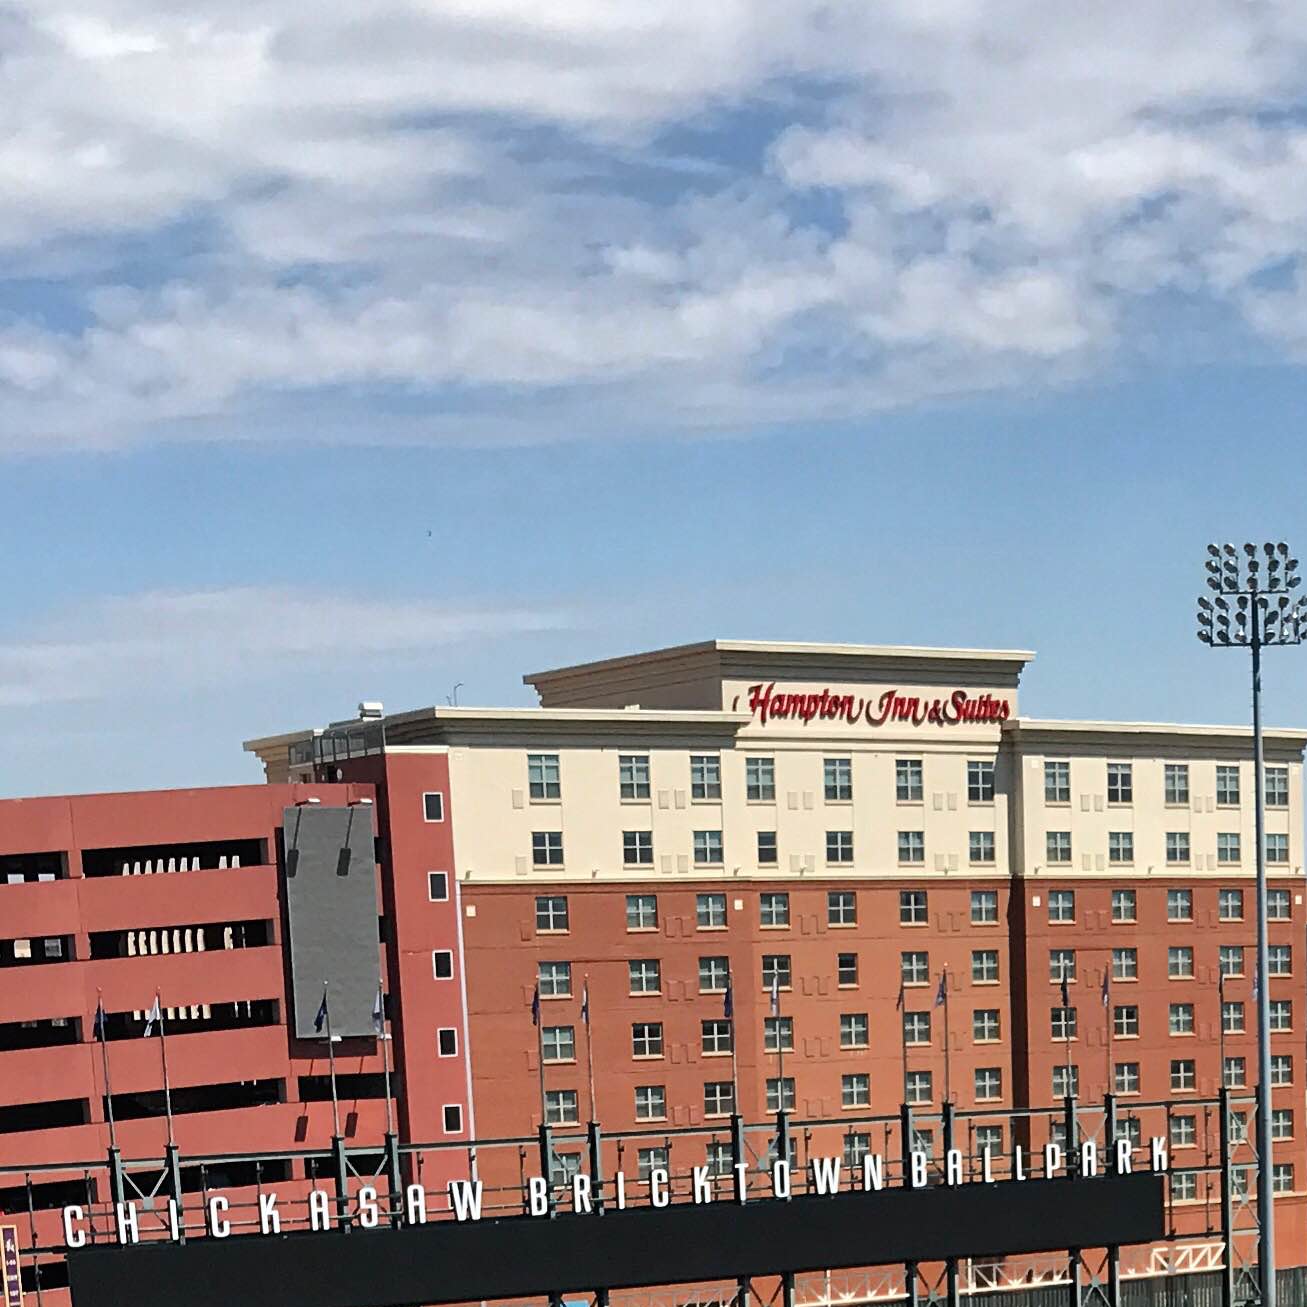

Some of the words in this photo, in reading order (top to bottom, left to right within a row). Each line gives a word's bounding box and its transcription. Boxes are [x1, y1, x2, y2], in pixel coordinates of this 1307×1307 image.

[748, 681, 864, 727] Hampton
[866, 690, 928, 727] Inn
[943, 690, 1010, 725] Suites
[63, 1181, 484, 1249] CHICKASAW
[530, 1154, 884, 1217] BRICKTOWN
[911, 1136, 1170, 1189] BALLPARK
